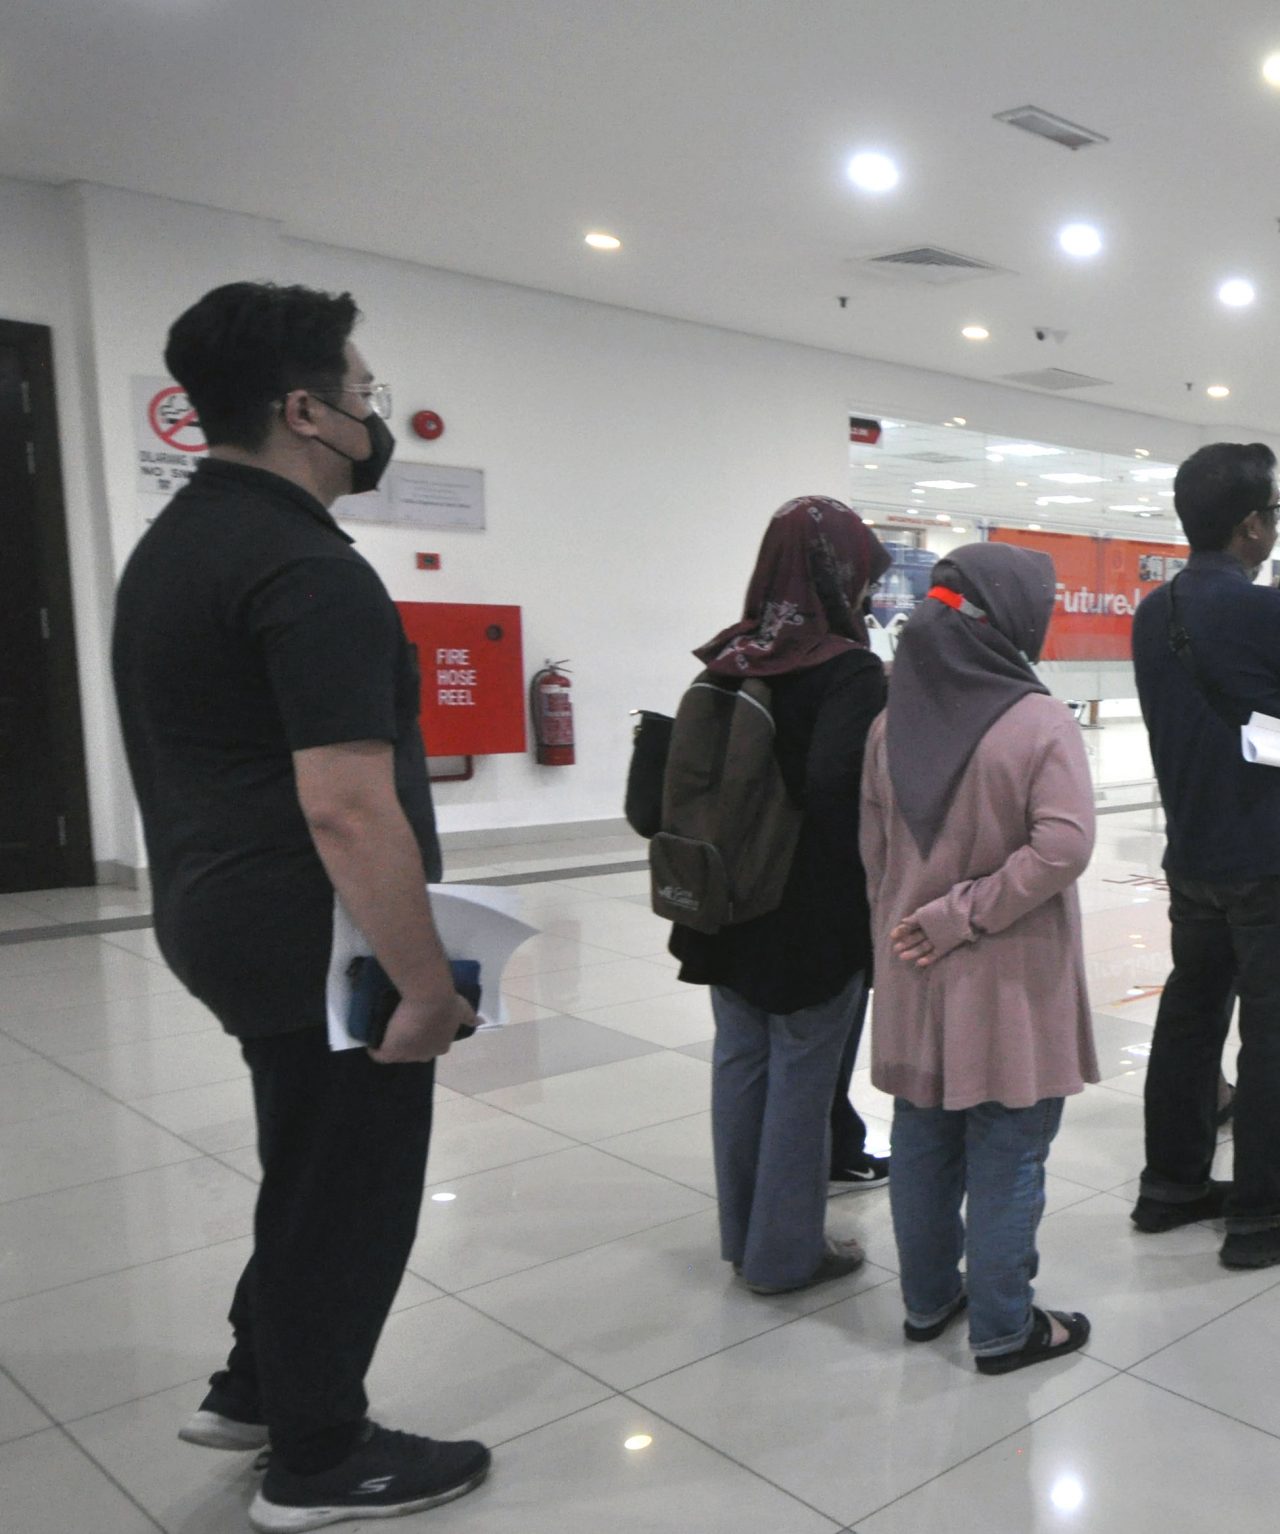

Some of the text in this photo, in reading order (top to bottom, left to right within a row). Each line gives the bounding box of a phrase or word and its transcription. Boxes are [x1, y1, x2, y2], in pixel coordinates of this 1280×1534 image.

[436, 648, 471, 665] FIRE
[437, 669, 477, 686] HOSE
[438, 689, 476, 706] REEL
